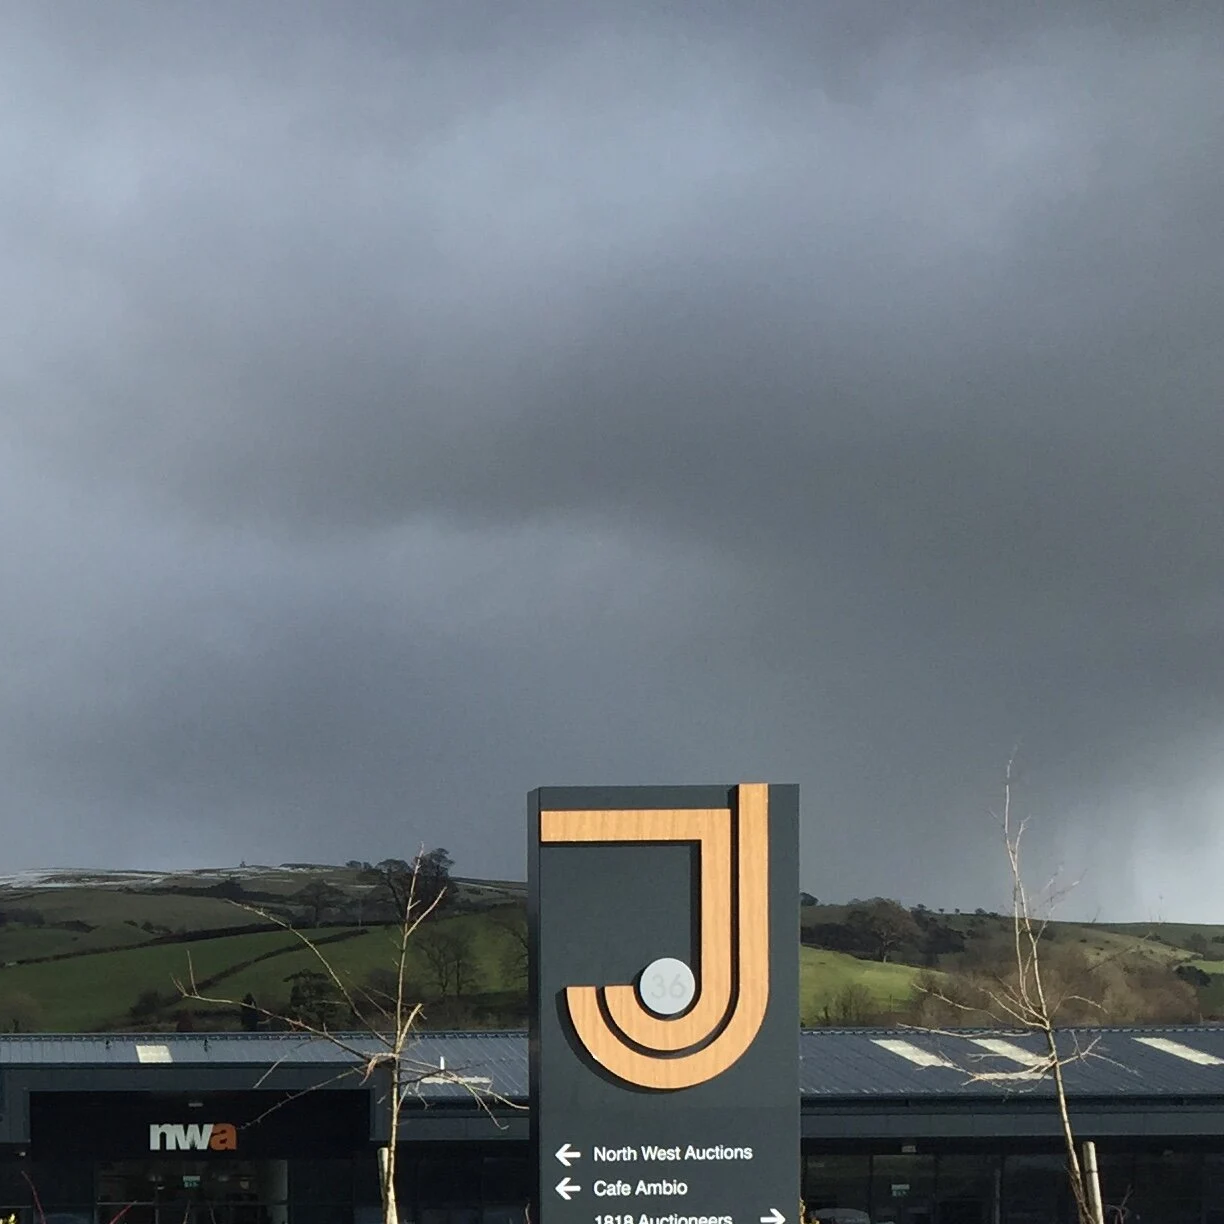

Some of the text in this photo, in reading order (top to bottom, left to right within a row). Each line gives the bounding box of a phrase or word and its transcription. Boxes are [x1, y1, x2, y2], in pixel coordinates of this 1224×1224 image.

[651, 973, 686, 999] 36
[149, 1123, 237, 1150] nwa
[593, 1144, 753, 1162] North West Auctions
[593, 1179, 688, 1197] Cafe Ambio
